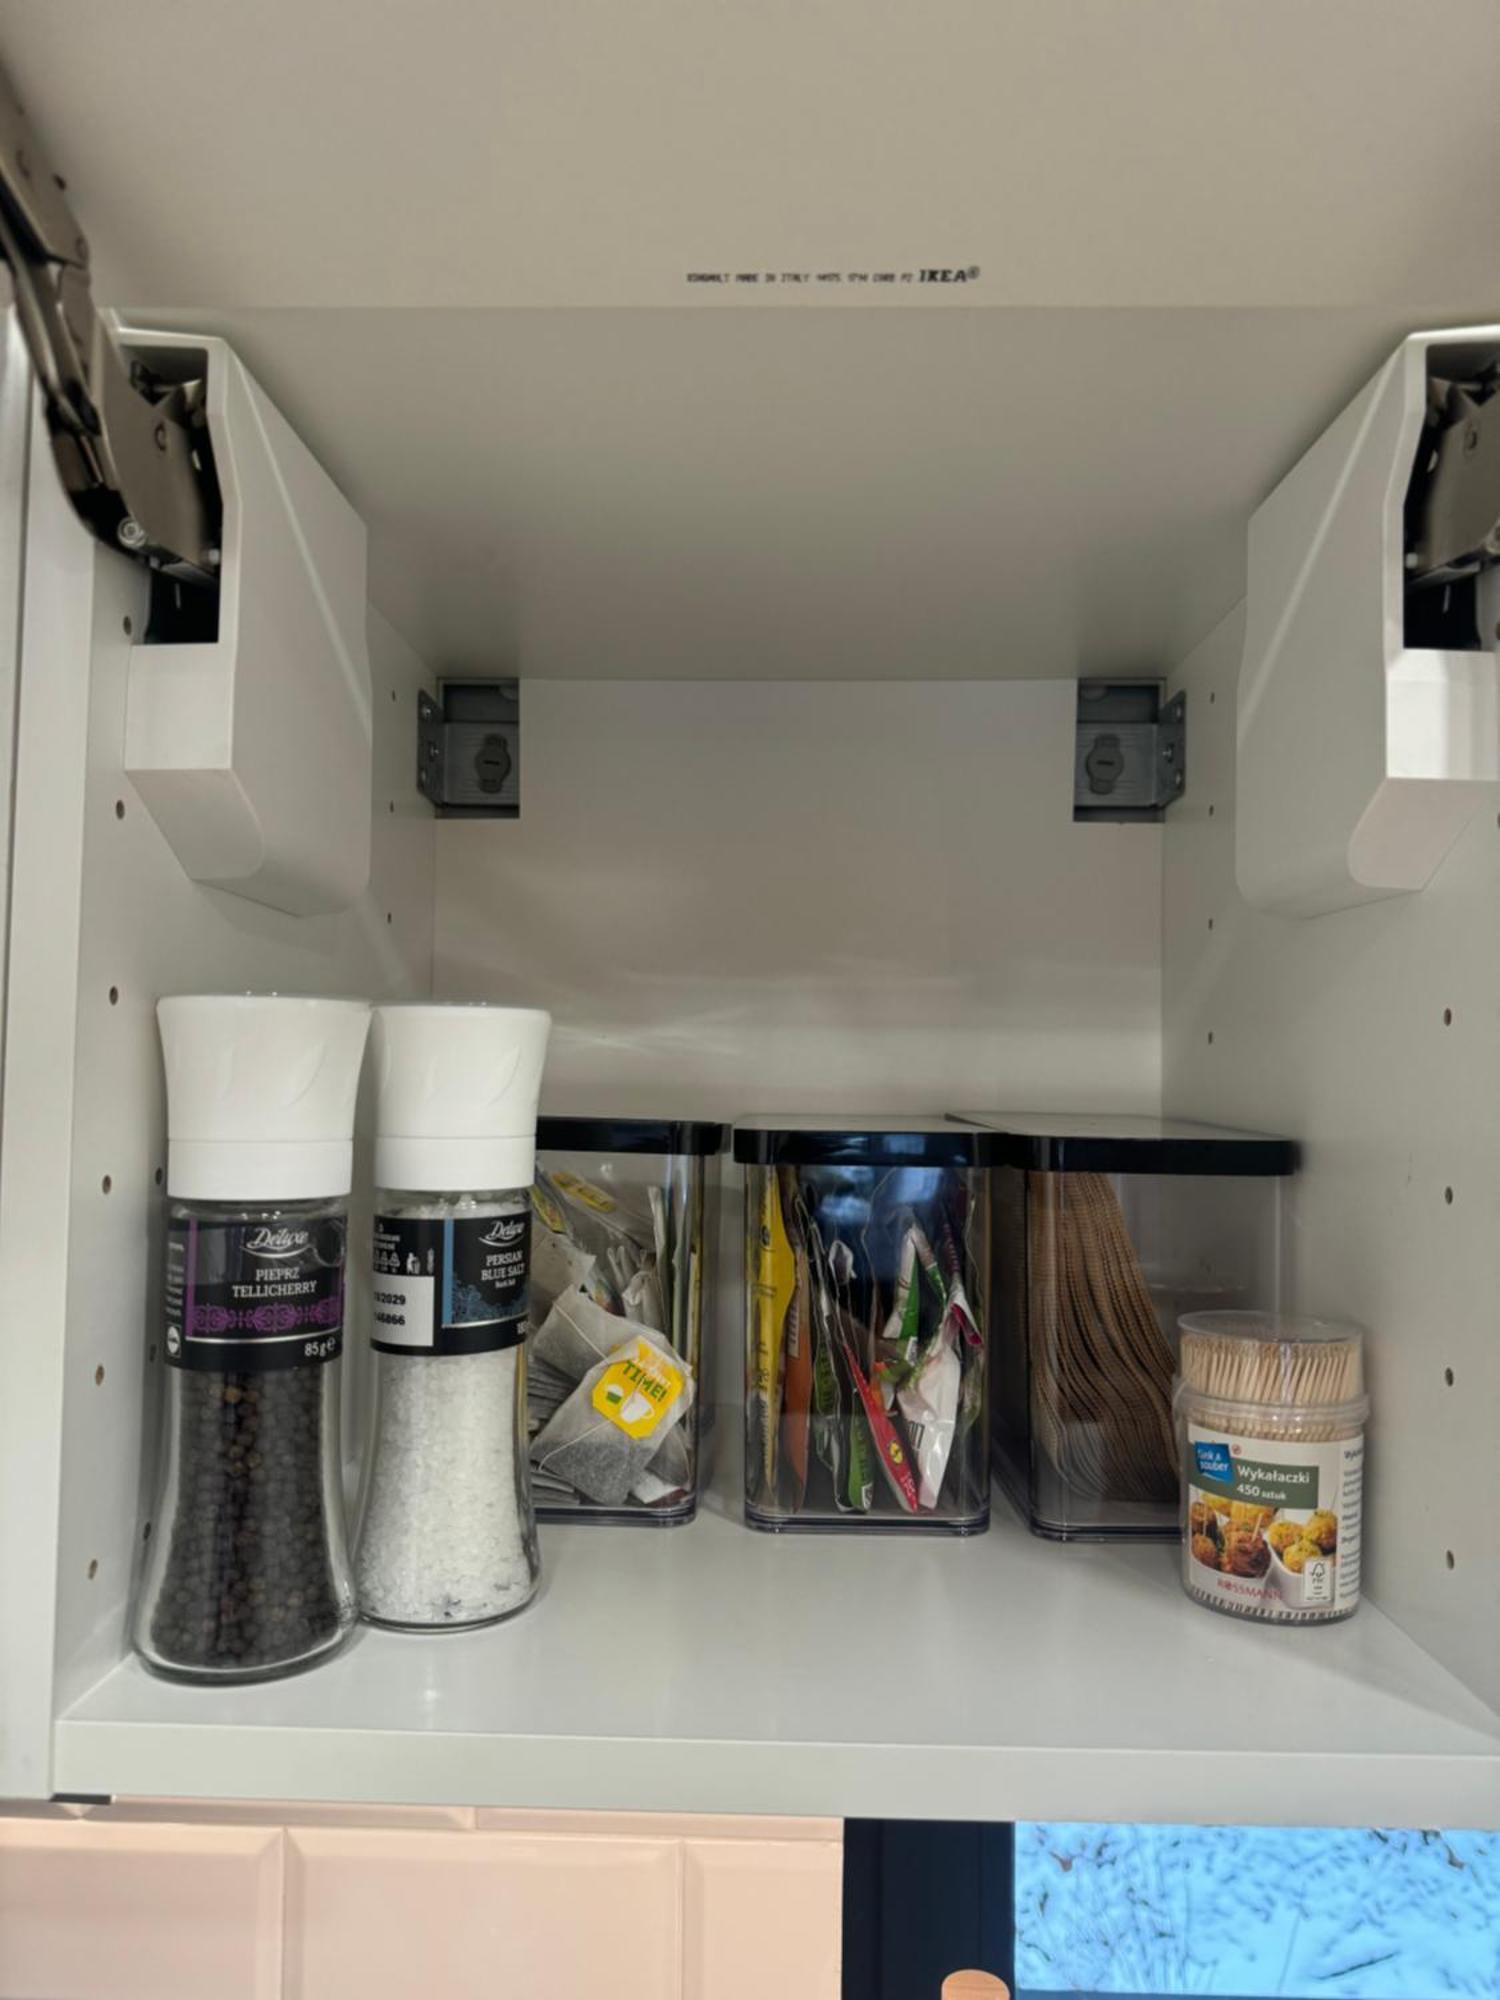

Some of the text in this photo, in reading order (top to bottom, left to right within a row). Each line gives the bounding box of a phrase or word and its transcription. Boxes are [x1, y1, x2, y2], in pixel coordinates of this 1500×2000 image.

[246, 1227, 309, 1251] Deluxe
[486, 1250, 523, 1266] PERSIAN
[255, 1267, 300, 1282] PIEPRZ
[481, 1267, 506, 1281] BLUE
[232, 1280, 317, 1298] TELLICHERRY
[1237, 1464, 1310, 1484] Wykałaczki
[1237, 1484, 1287, 1500] 450 sztuk
